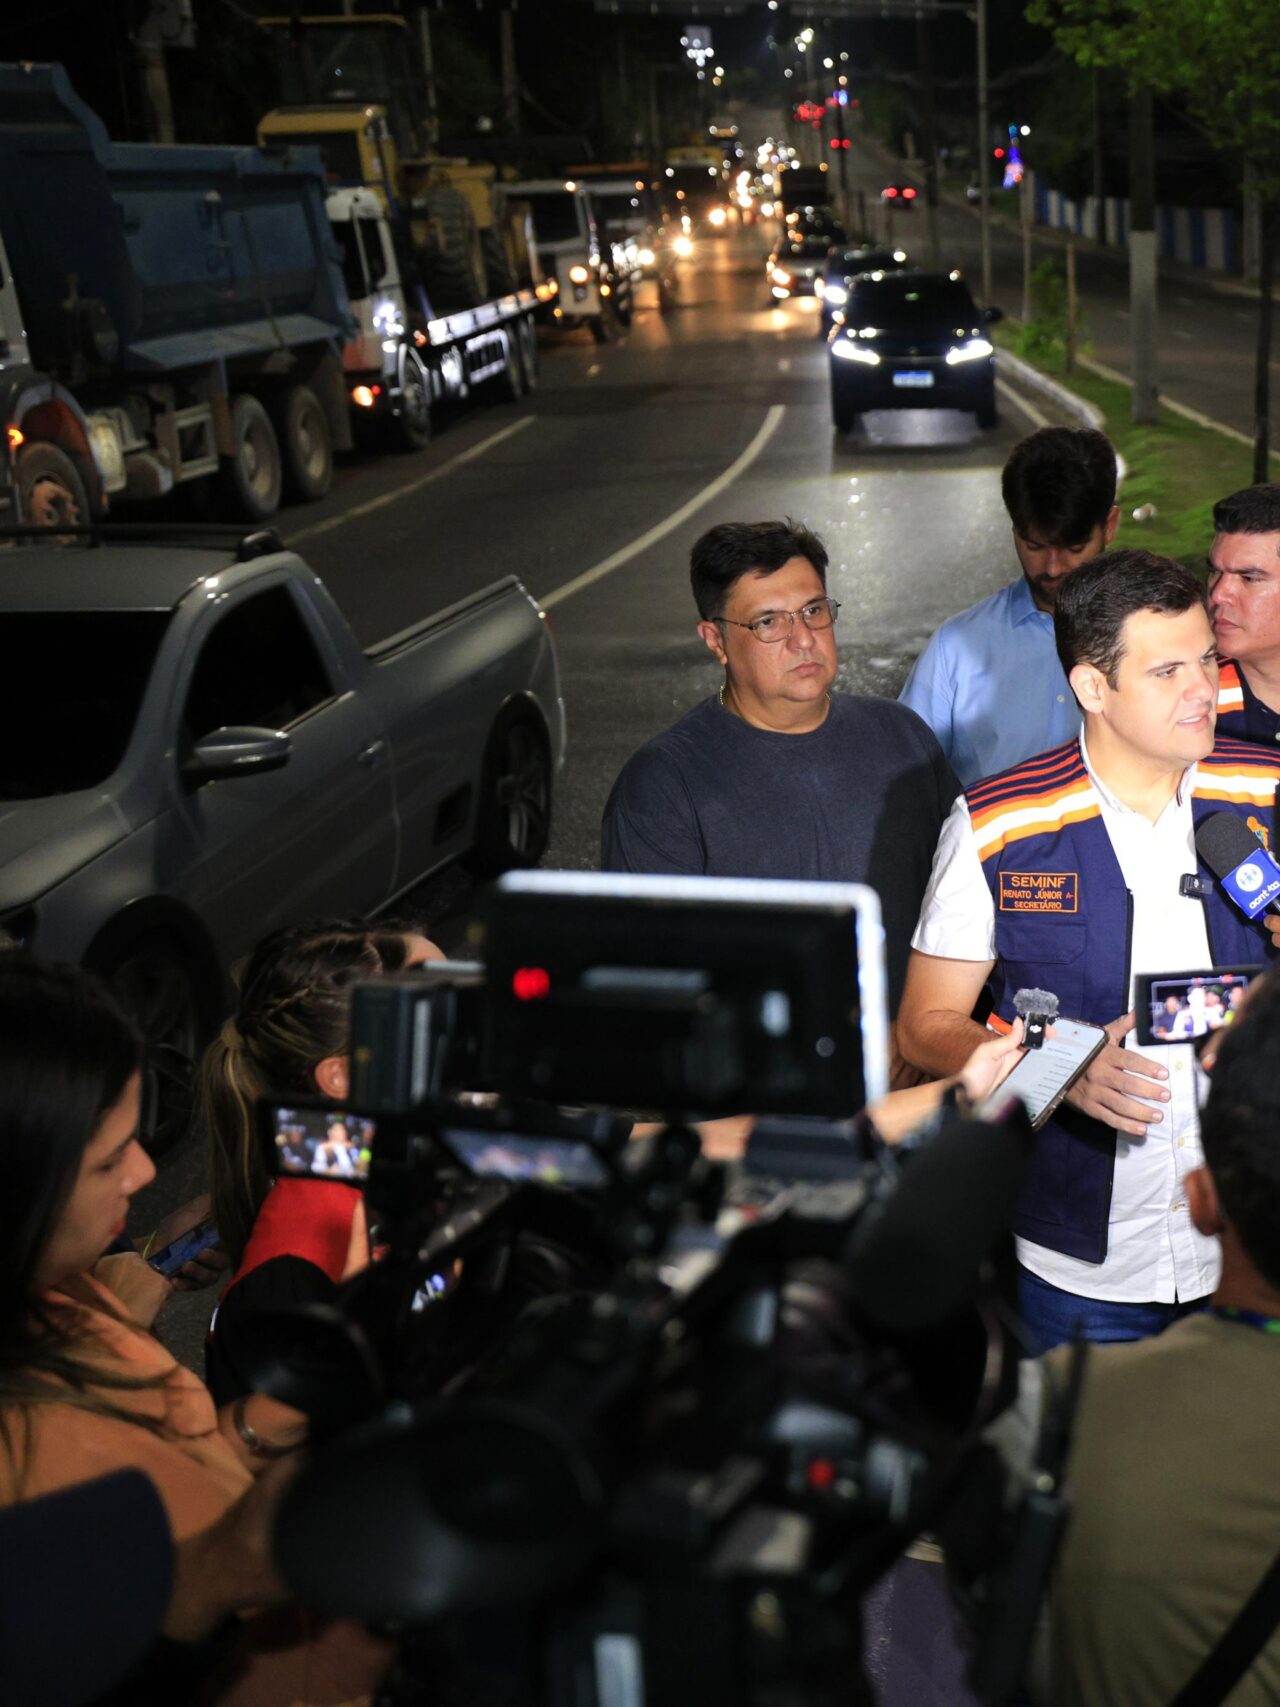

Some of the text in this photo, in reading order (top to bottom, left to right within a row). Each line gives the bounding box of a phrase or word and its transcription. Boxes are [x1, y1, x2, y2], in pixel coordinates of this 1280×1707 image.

[1011, 875, 1067, 889] SEMINF
[1003, 889, 1032, 899] RENATO
[1034, 887, 1063, 900] JÚNIOR
[1013, 899, 1063, 910] SECRETÁRIO
